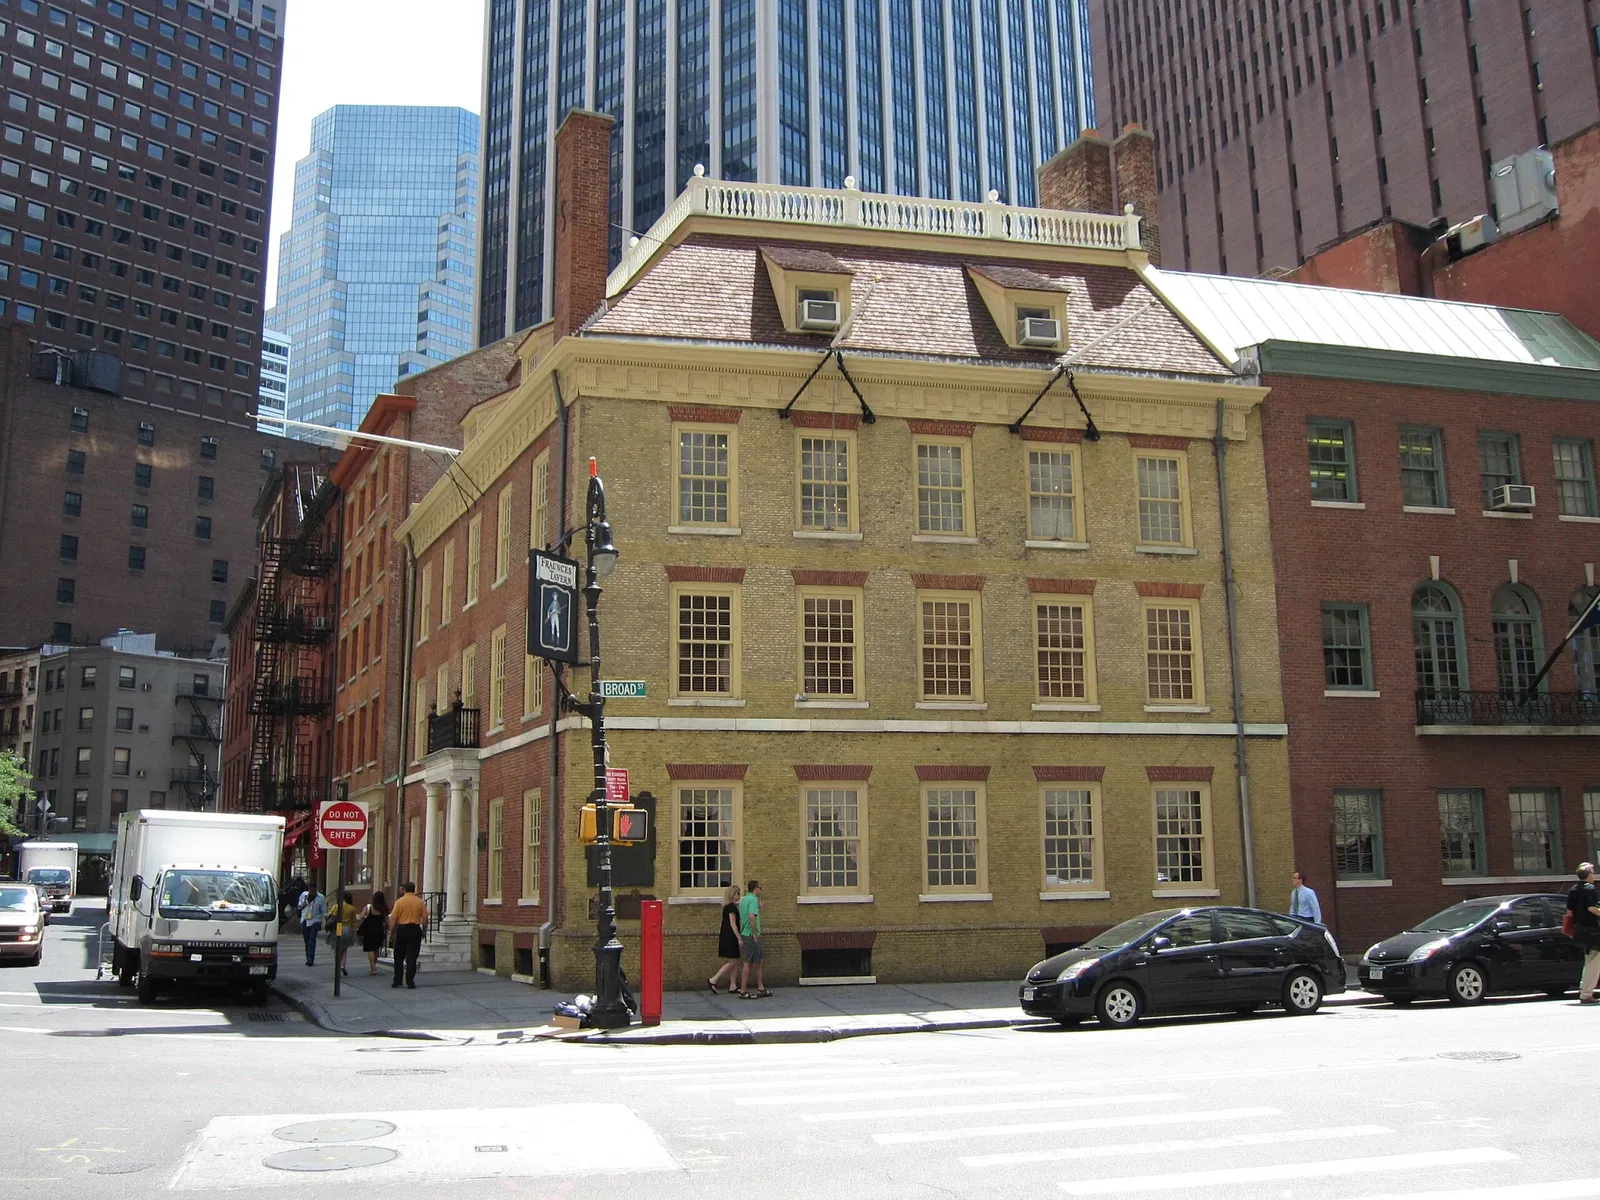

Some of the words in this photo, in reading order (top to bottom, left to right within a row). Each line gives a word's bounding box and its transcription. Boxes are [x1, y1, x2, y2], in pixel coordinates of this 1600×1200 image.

[541, 557, 572, 575] FRAUNCES
[550, 570, 572, 585] TAVERN
[605, 683, 637, 695] BROAD
[330, 831, 356, 839] ENTER
